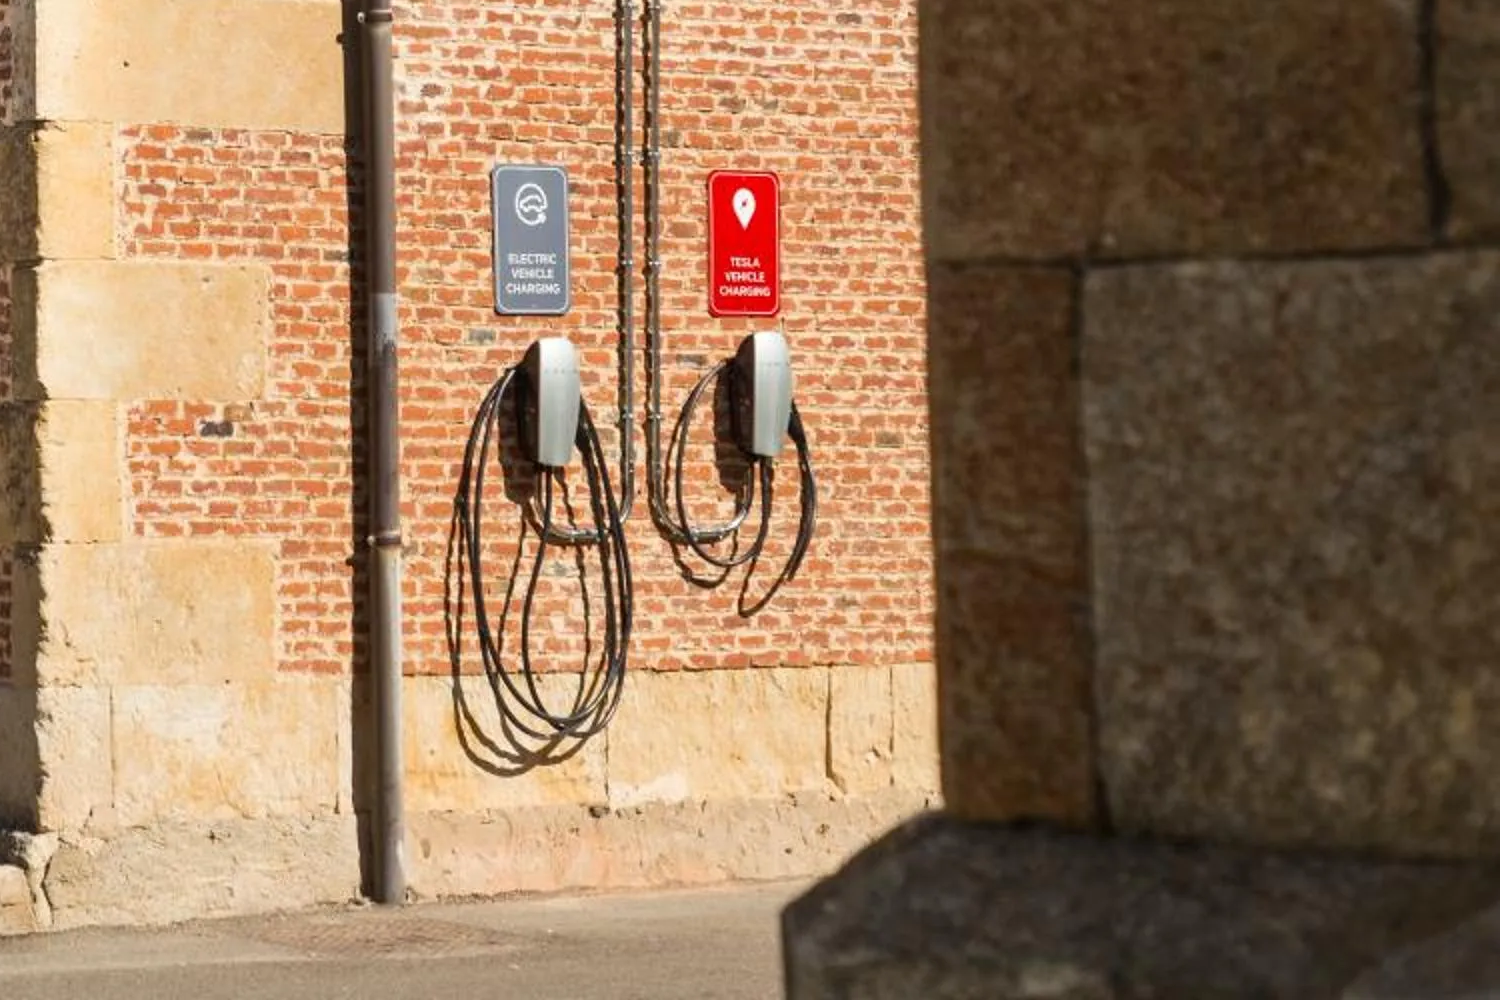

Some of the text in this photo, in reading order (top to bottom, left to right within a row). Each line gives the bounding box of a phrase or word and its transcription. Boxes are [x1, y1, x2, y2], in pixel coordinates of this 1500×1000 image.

[507, 253, 557, 265] ELECTRIC
[729, 255, 761, 269] TESLA
[511, 267, 555, 279] VEHICLE
[723, 271, 766, 283] VEHICLE
[505, 283, 561, 295] CHARGING
[719, 285, 771, 297] CHARGING
